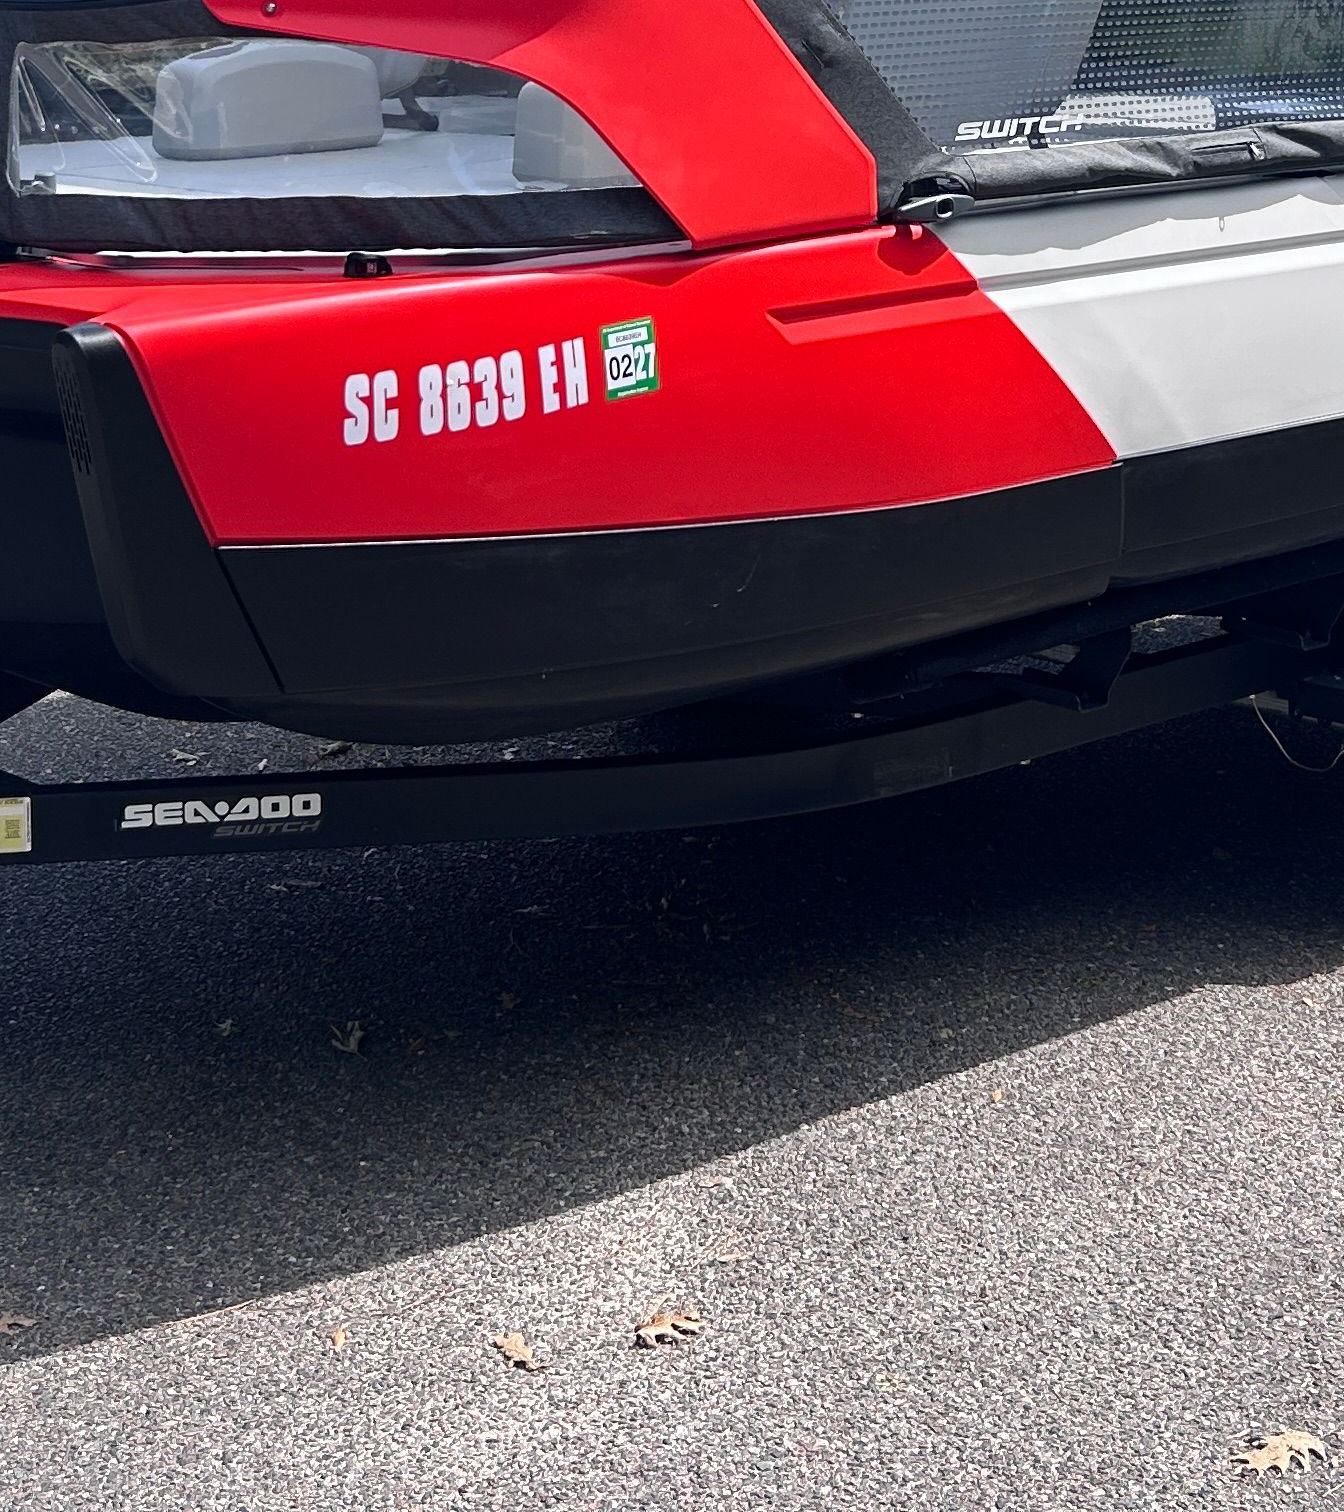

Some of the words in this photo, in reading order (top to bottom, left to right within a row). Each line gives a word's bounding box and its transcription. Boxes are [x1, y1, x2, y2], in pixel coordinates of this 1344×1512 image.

[609, 353, 633, 381] 02
[634, 343, 656, 381] 27
[343, 369, 399, 446] SC
[418, 349, 526, 436] 8639
[537, 336, 589, 415] EH
[212, 819, 321, 837] SWITCH
